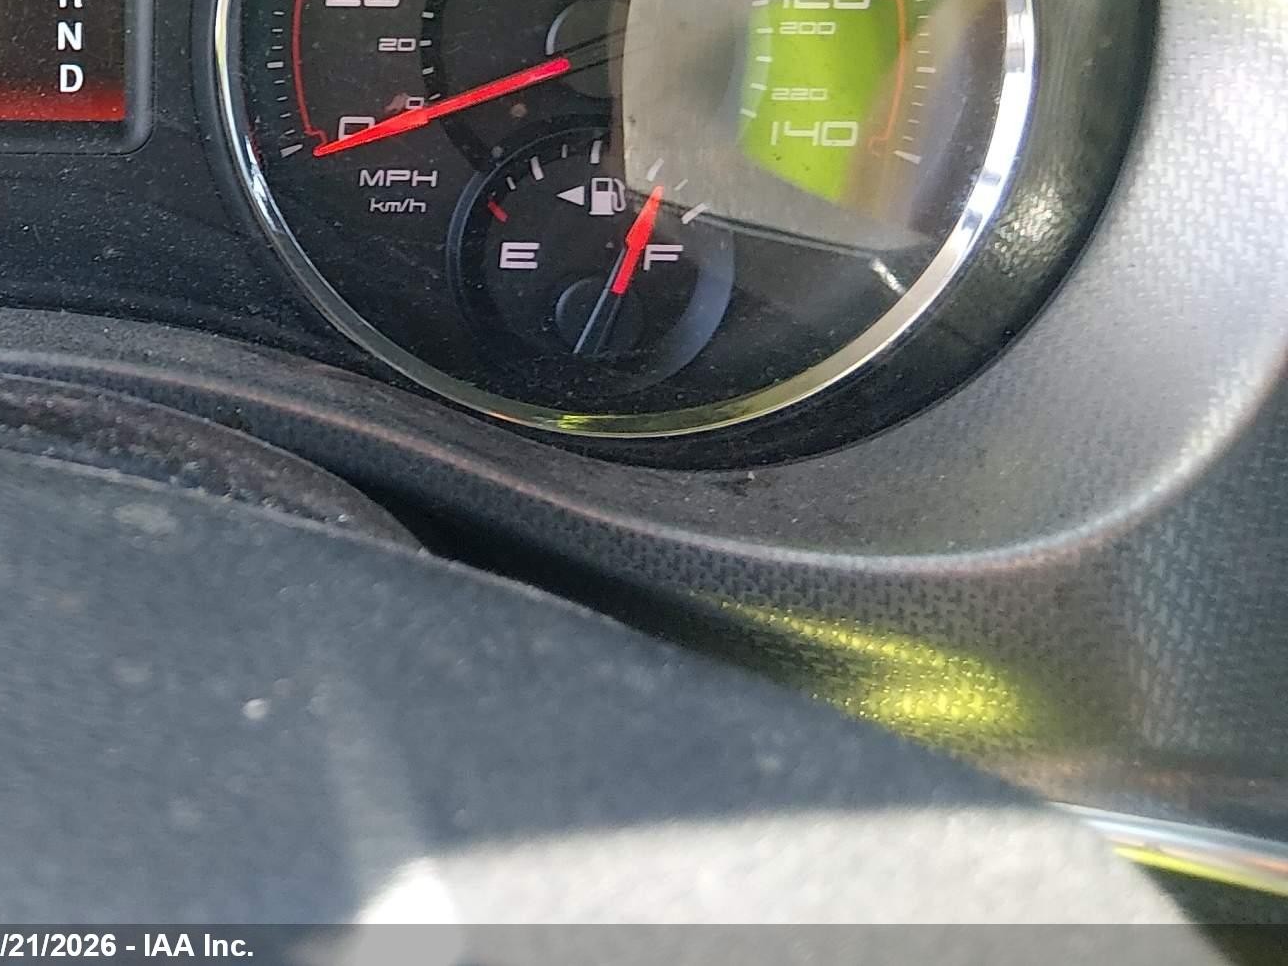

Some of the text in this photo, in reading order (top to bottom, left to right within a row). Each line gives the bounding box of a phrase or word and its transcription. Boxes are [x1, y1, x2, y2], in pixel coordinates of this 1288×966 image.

[57, 22, 83, 51] N
[778, 21, 837, 35] 200
[377, 38, 417, 52] 20
[60, 64, 85, 92] D
[770, 87, 829, 101] 220
[770, 120, 859, 147] 140
[359, 169, 439, 188] MPH
[369, 197, 427, 213] km/h
[499, 242, 540, 270] E
[642, 244, 684, 271] F
